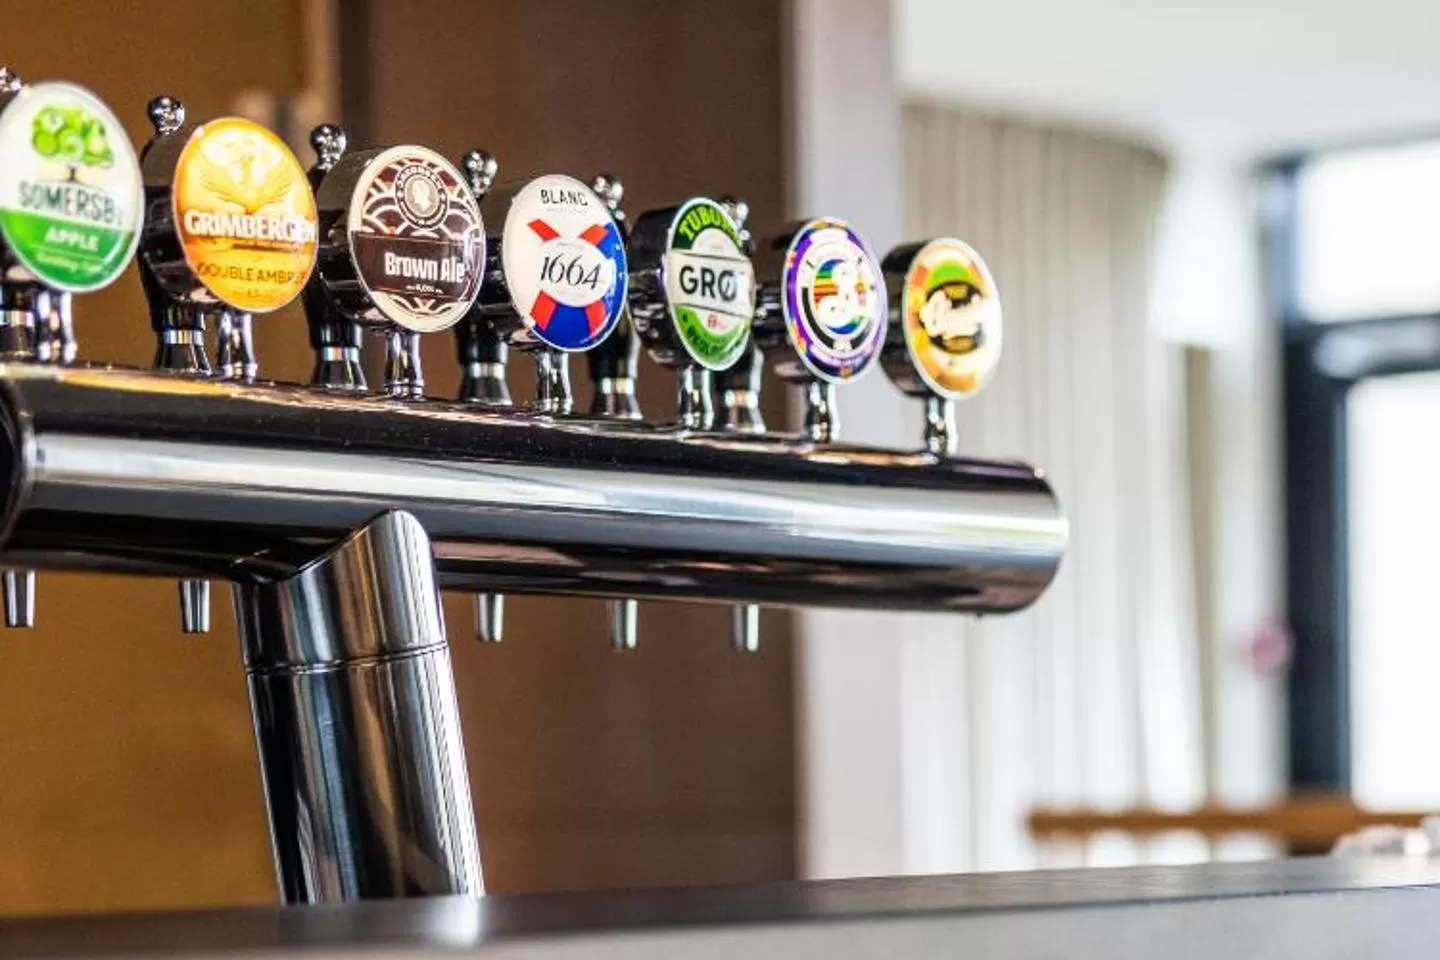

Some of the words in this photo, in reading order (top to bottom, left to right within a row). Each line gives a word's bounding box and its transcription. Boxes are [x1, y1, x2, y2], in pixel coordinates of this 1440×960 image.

[19, 180, 122, 225] SOMERSB
[541, 189, 588, 206] BLANC
[44, 226, 99, 252] APPLE
[197, 262, 254, 282] DOUBLE
[385, 252, 438, 281] Brown
[441, 256, 465, 283] Ale
[540, 252, 601, 290] 1664
